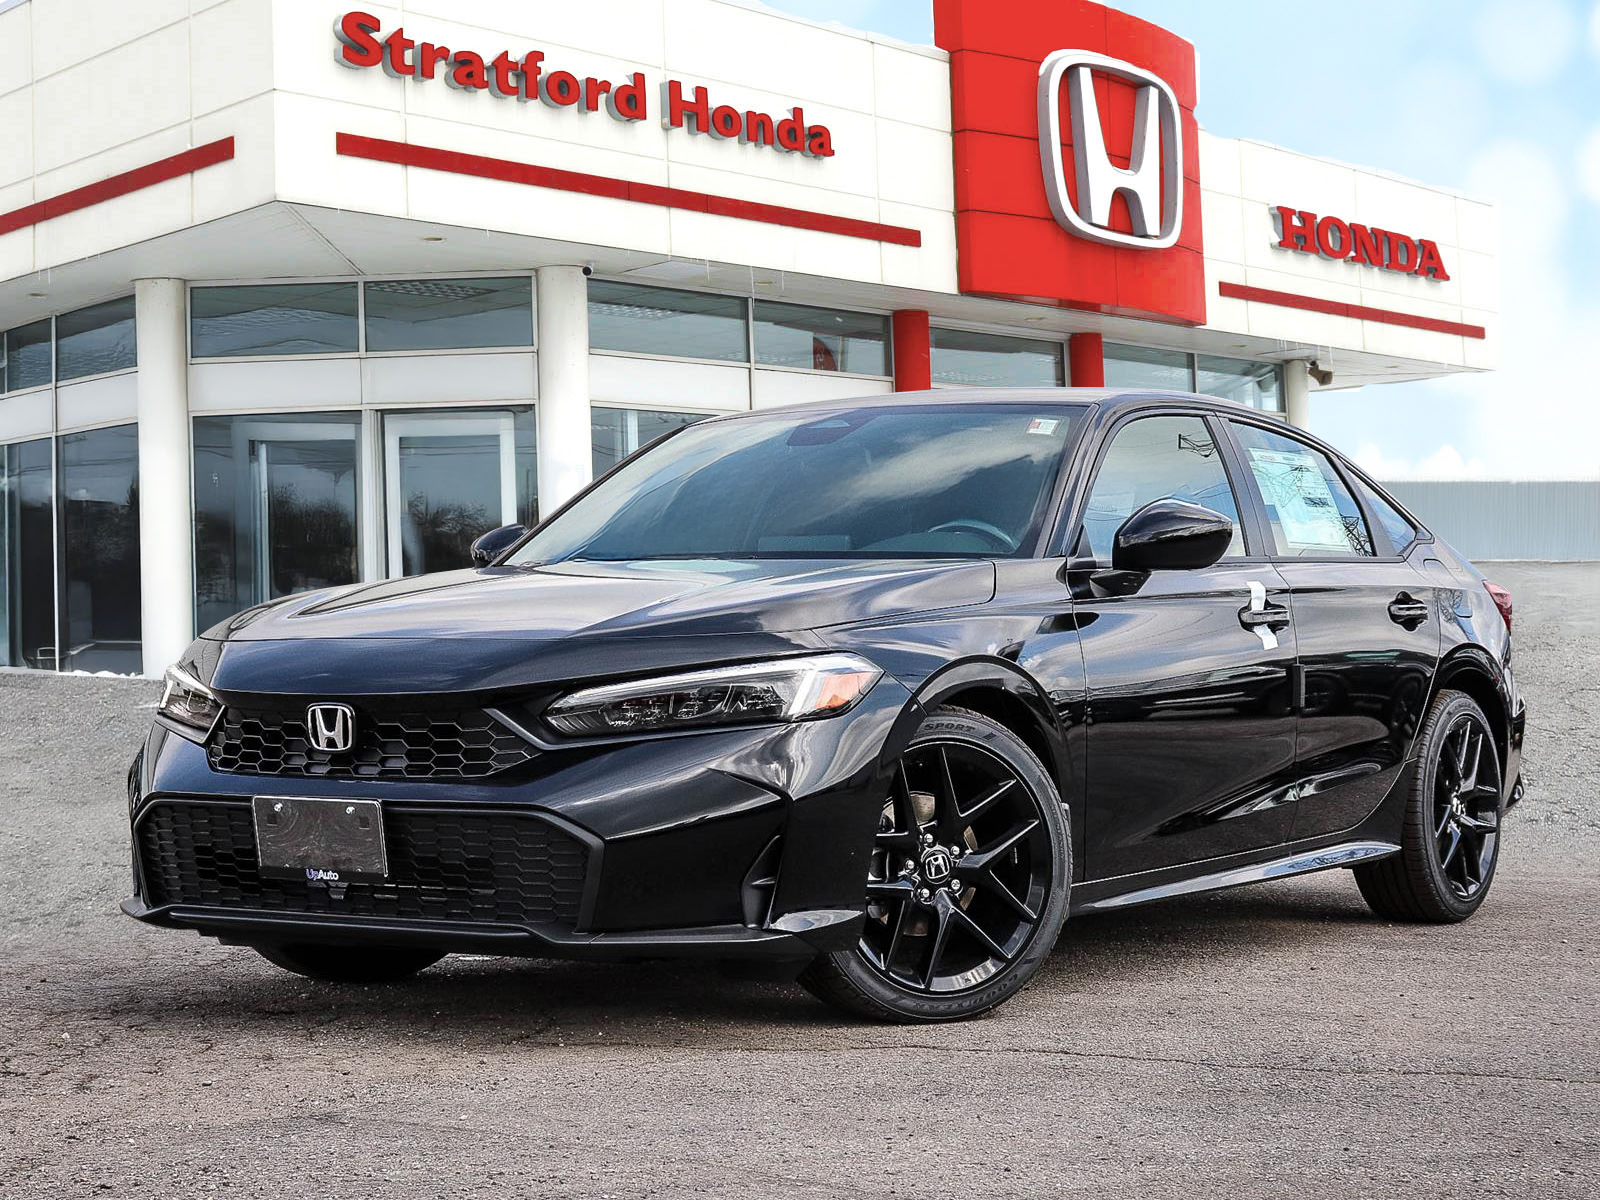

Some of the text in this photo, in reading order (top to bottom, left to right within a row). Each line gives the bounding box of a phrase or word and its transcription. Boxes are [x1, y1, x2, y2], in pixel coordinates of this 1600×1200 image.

[337, 11, 836, 158] Stratford Honda
[1271, 205, 1451, 282] HONDA
[924, 722, 976, 732] SPORT
[305, 868, 339, 881] UpAuto
